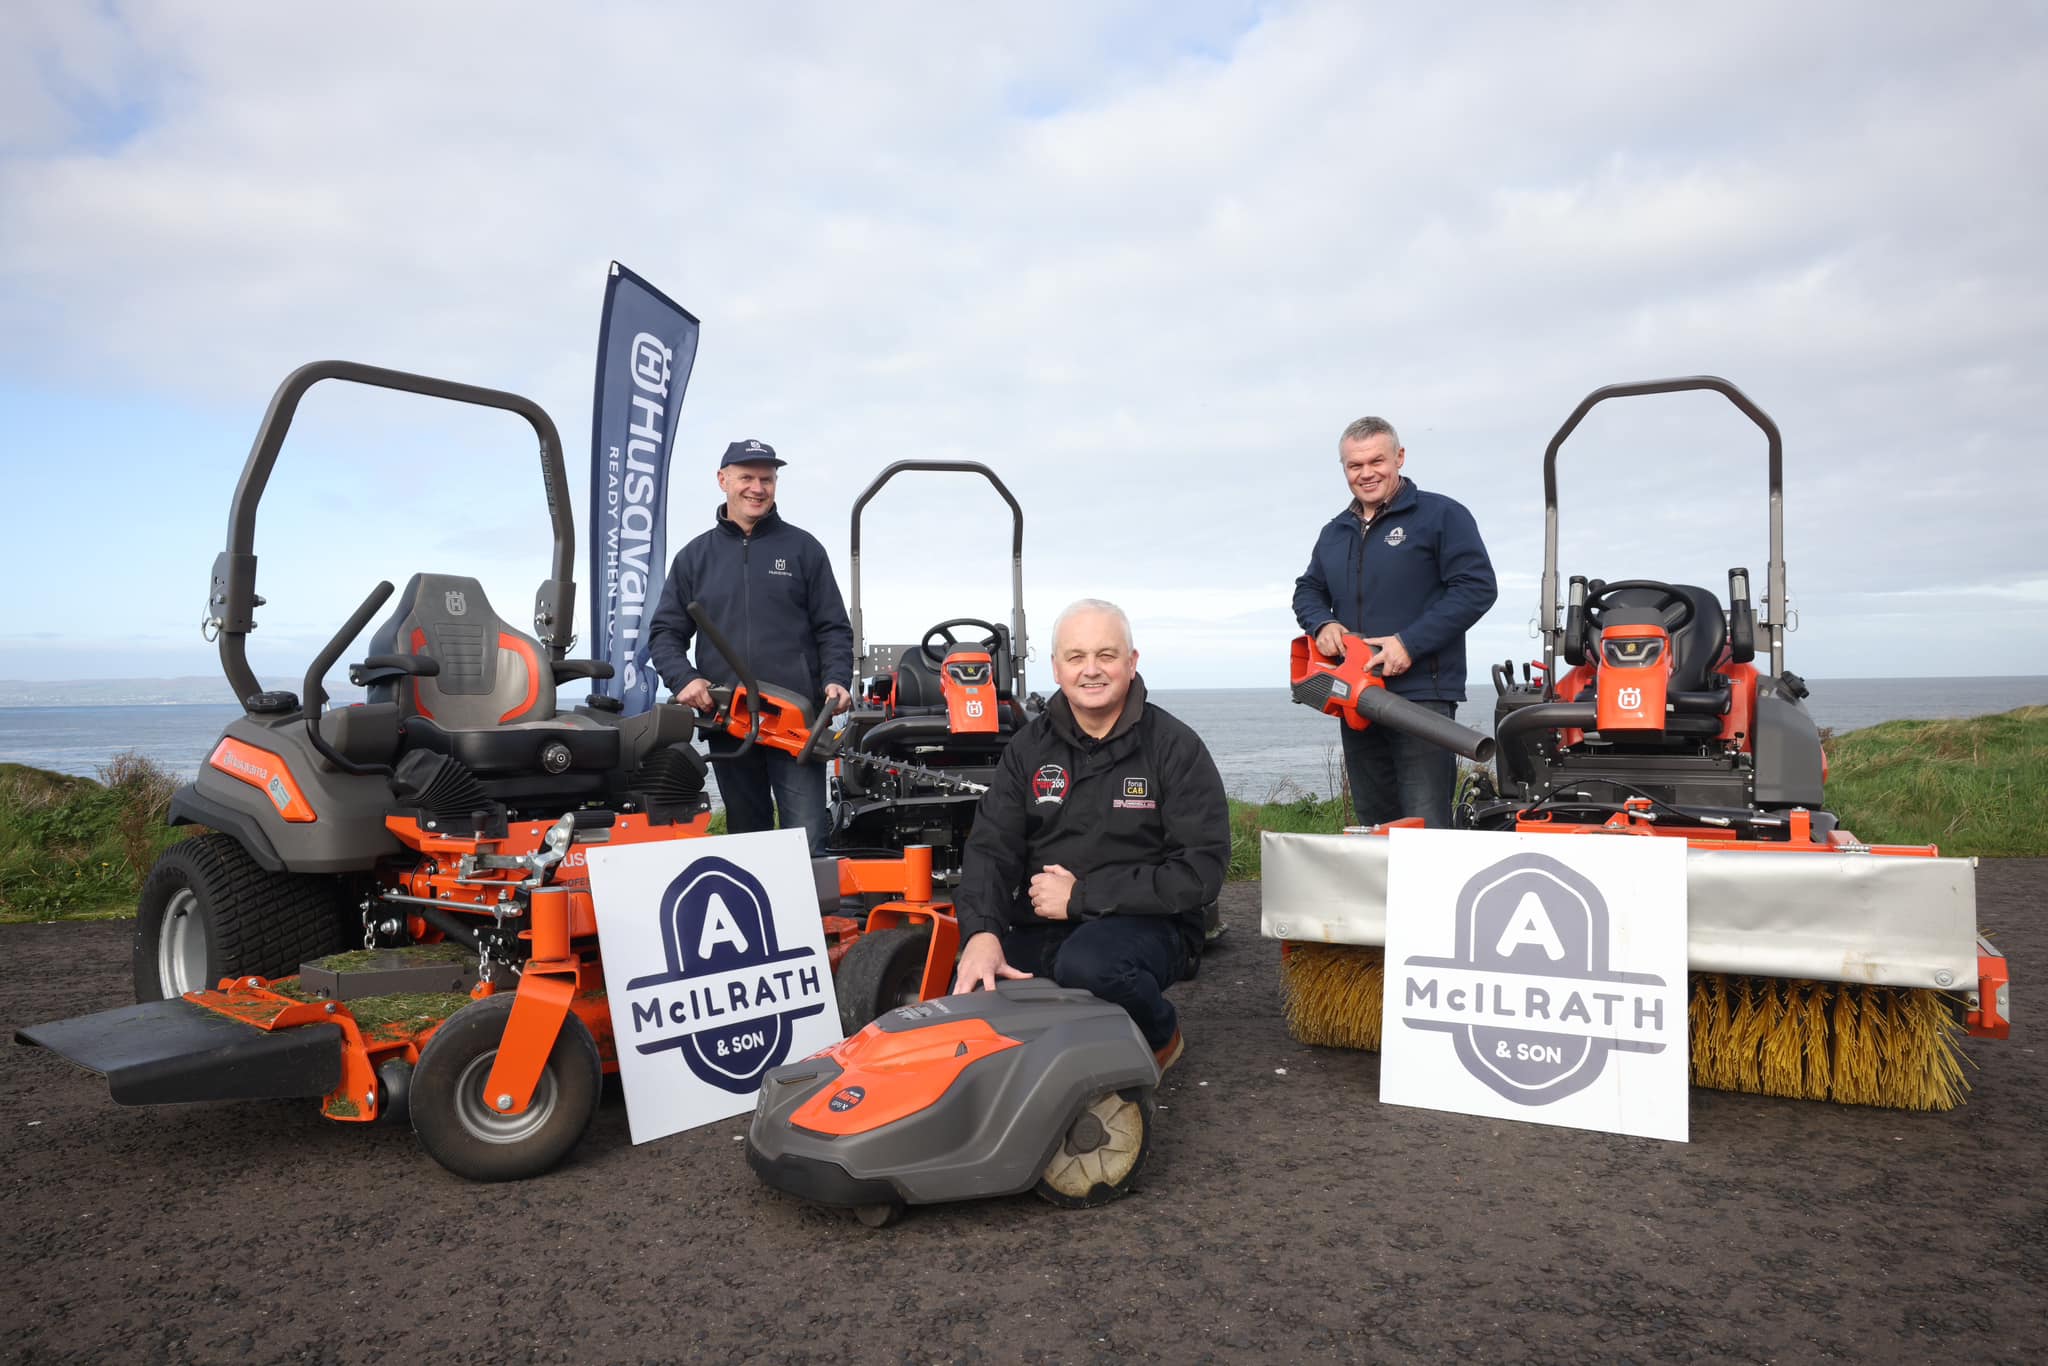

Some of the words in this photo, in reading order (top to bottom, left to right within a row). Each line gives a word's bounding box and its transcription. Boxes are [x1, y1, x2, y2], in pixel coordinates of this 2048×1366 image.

[607, 446, 619, 519] READY
[607, 527, 619, 598] WHEN
[1051, 781, 1065, 789] 200
[698, 893, 749, 960] A
[1495, 891, 1566, 961] A
[631, 966, 821, 1033] McILRATH
[1405, 976, 1664, 1031] McILRATH
[717, 1040, 730, 1057] &
[732, 1030, 765, 1053] SON
[1495, 1040, 1511, 1059] &
[1517, 1043, 1562, 1064] SON
